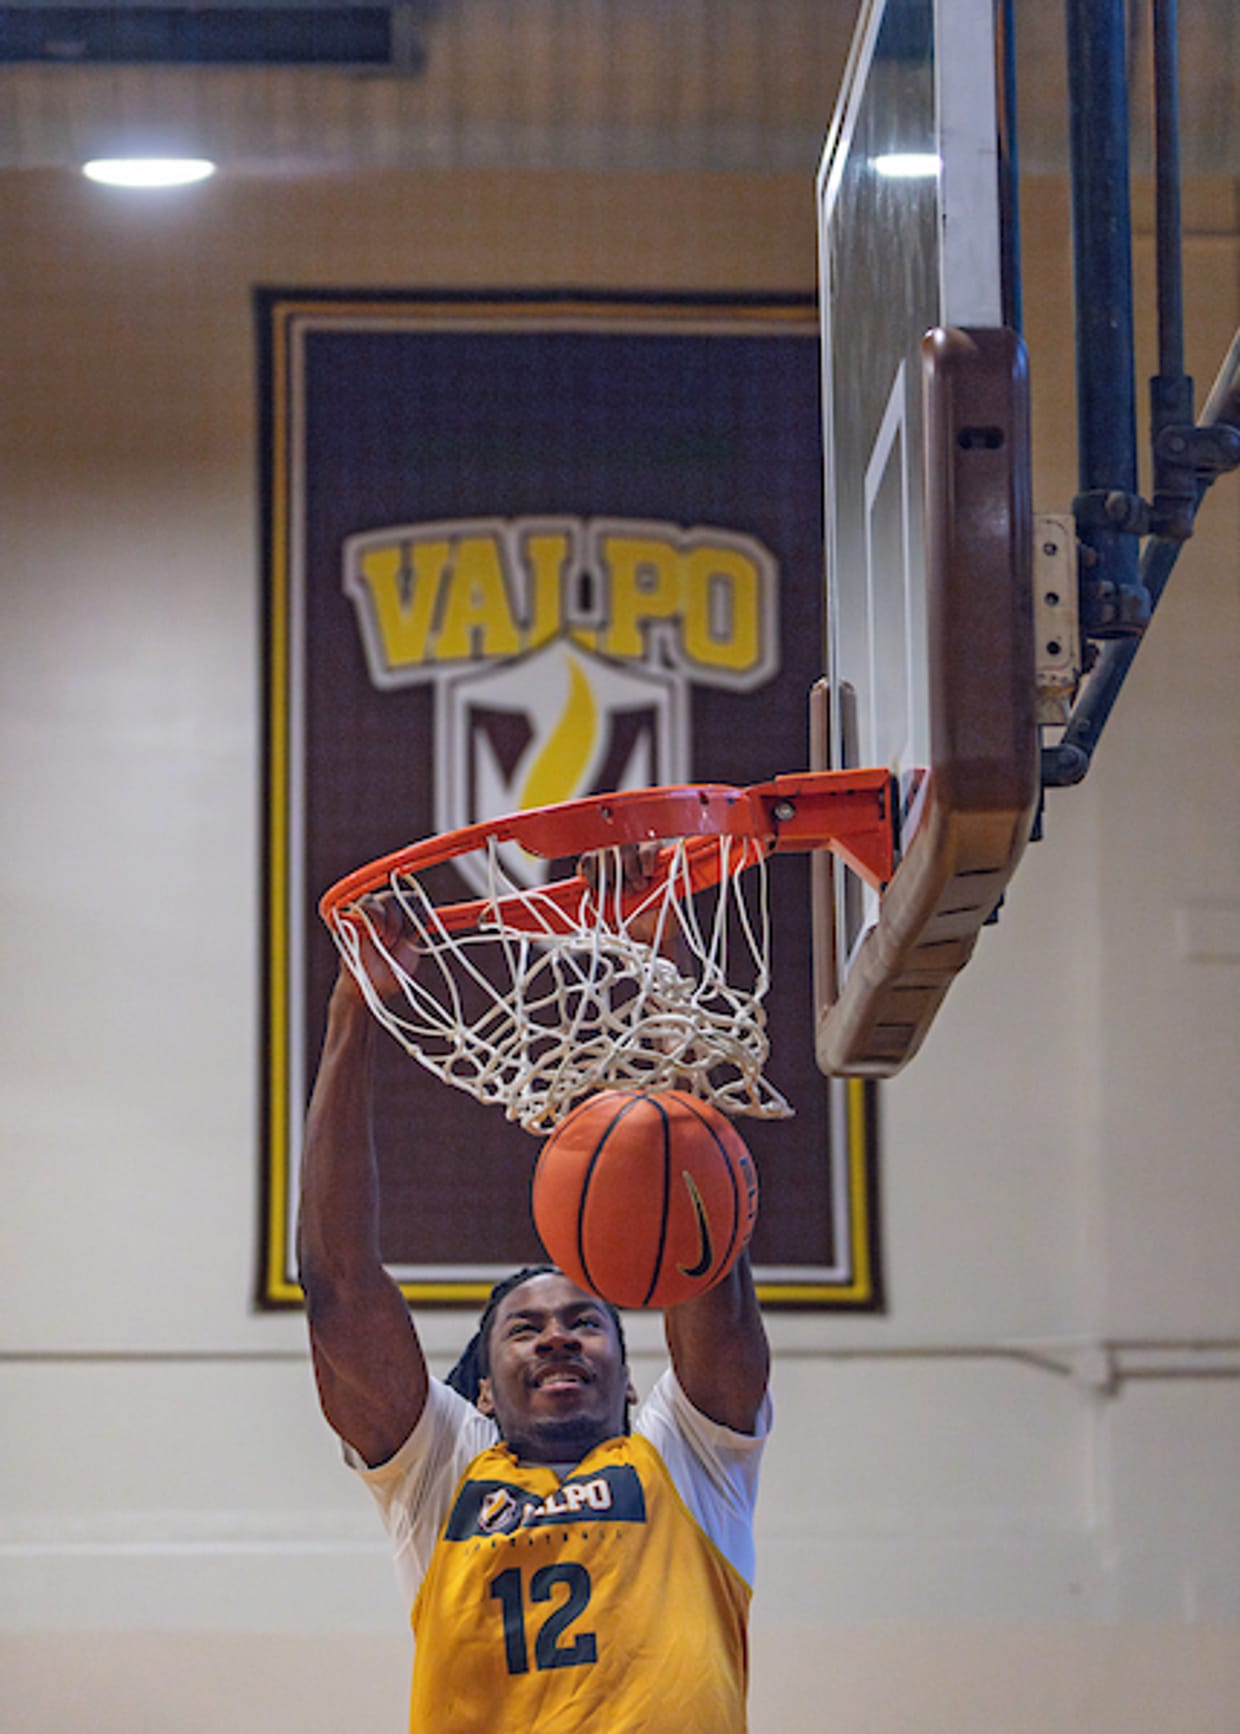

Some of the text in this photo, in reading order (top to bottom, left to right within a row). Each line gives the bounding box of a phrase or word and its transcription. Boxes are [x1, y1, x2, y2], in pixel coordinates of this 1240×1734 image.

[357, 532, 761, 673] VALPO
[521, 1478, 612, 1526] LPO
[490, 1562, 597, 1675] 12
